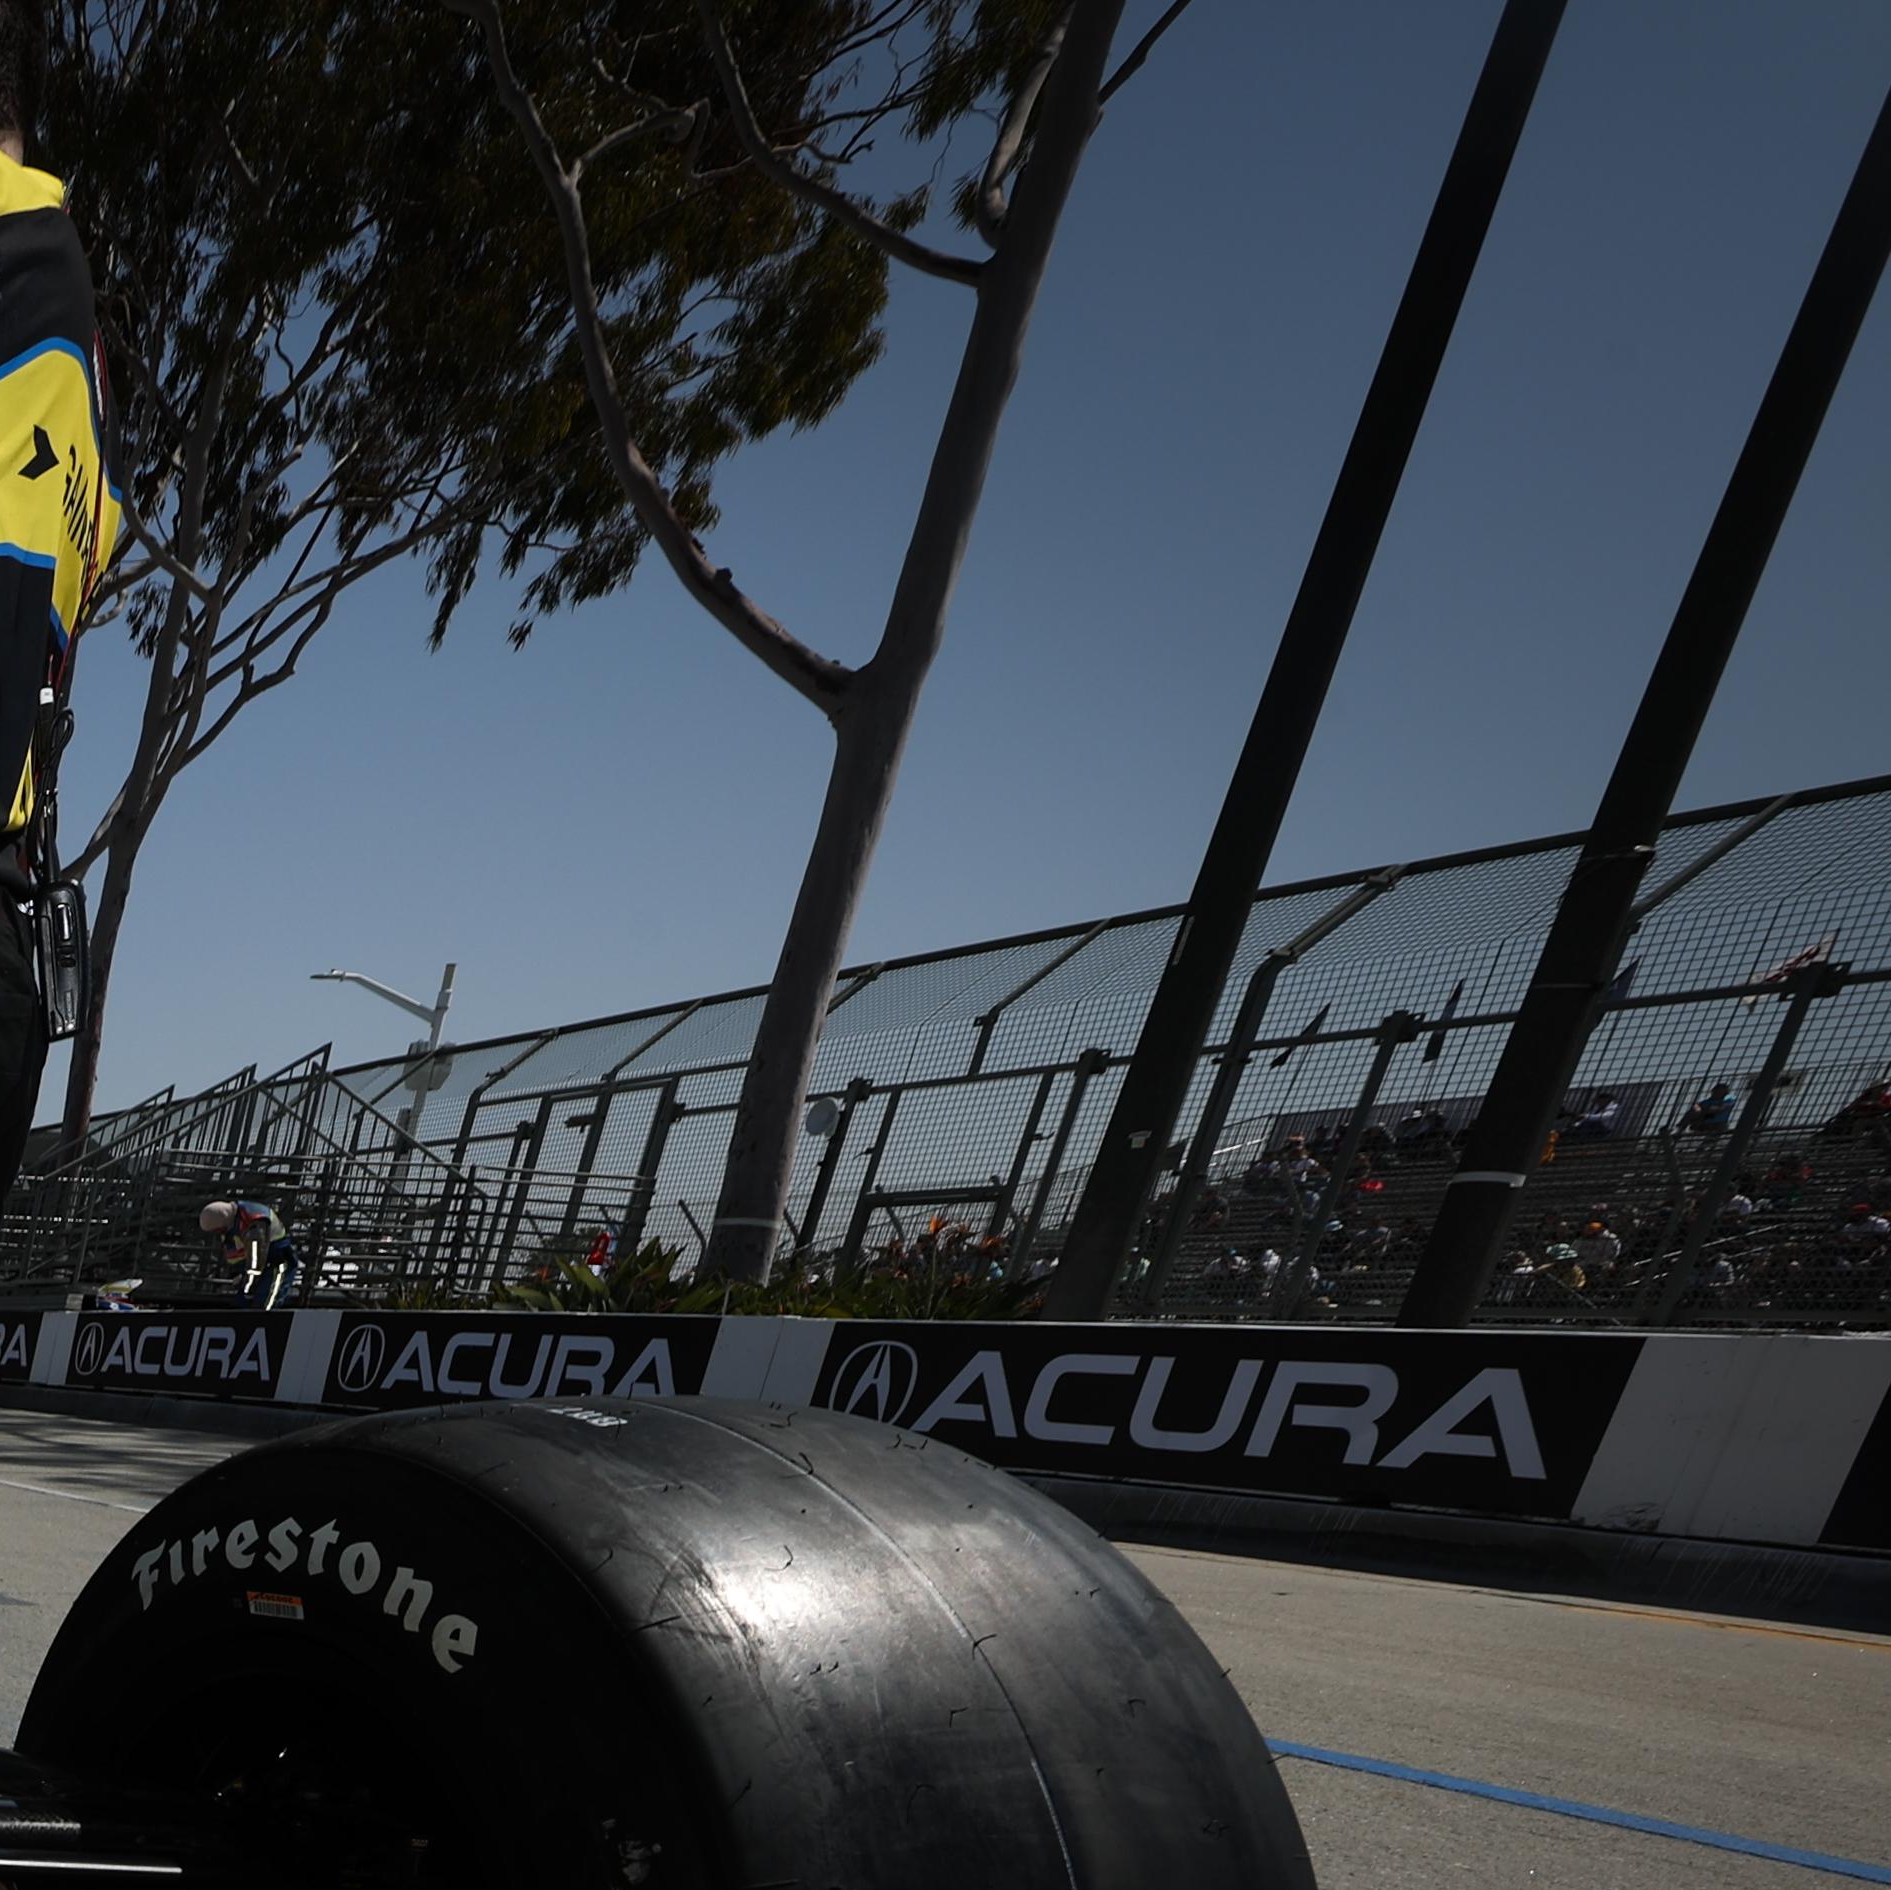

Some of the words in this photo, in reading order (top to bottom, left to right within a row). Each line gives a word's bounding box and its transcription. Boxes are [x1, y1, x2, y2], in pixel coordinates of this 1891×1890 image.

[102, 1324, 271, 1382] ACURA
[382, 1328, 678, 1398] ACURA
[911, 1350, 1547, 1480] ACURA
[130, 1515, 479, 1674] Firestone
